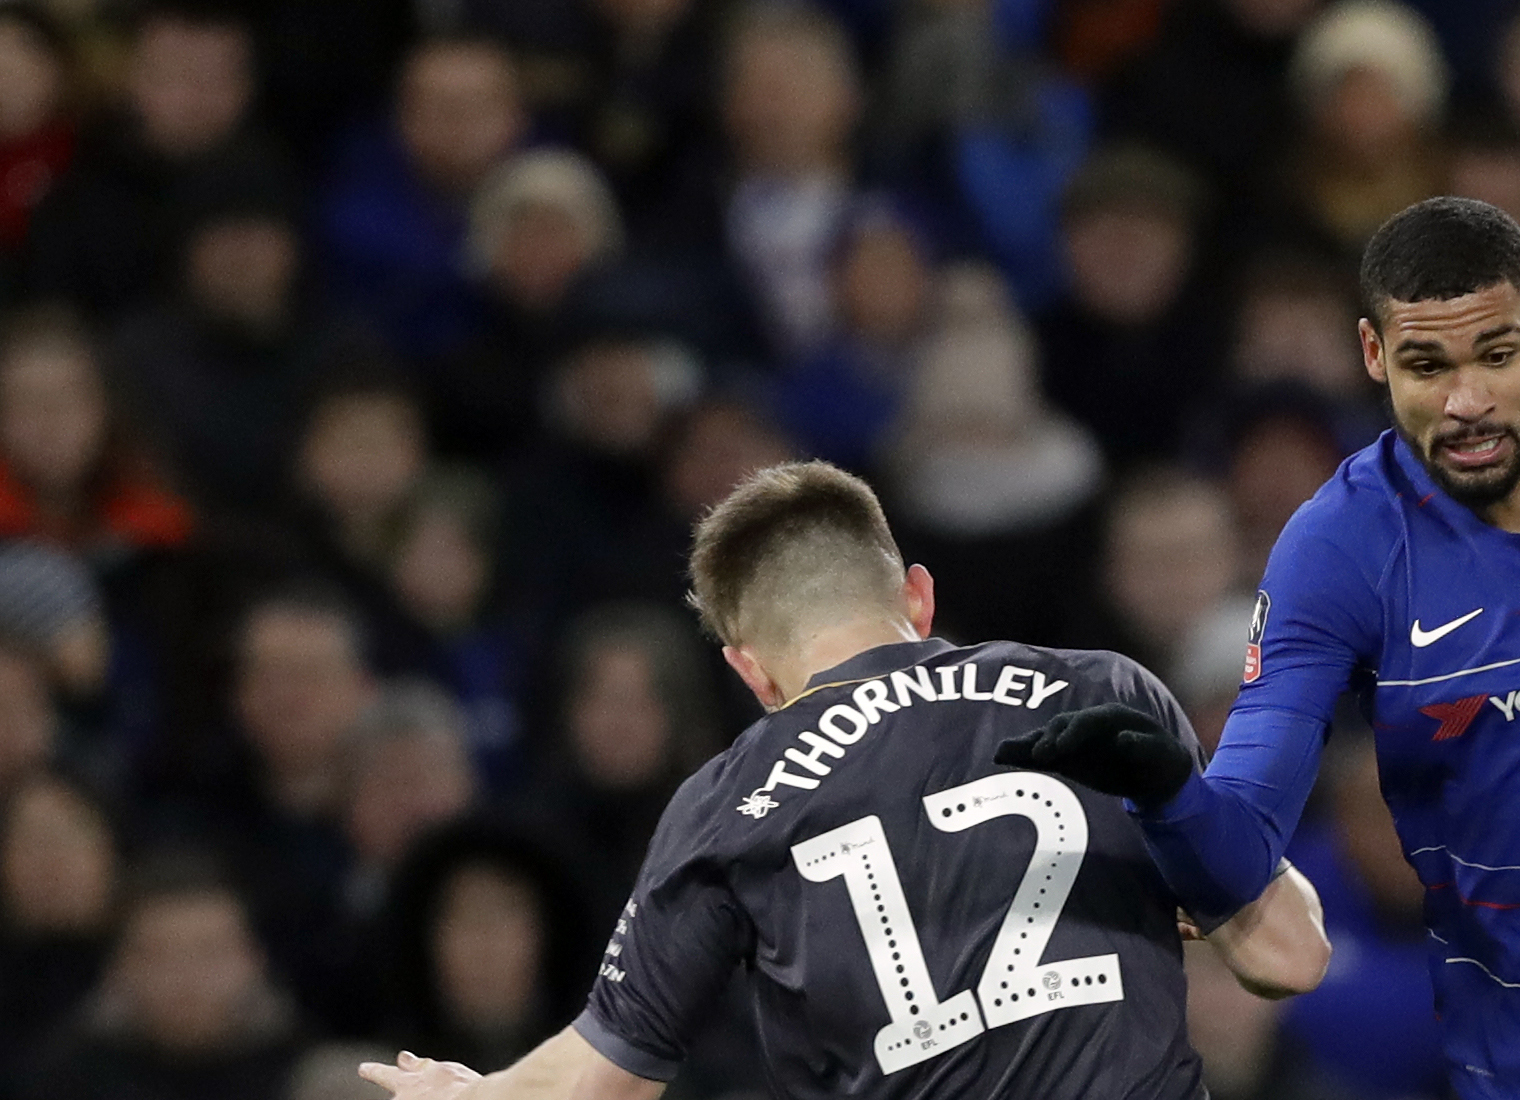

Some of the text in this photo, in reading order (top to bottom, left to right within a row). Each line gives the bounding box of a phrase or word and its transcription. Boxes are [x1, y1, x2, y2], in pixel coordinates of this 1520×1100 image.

[764, 662, 1069, 790] THORNILEY
[790, 771, 1124, 1076] 12
[1047, 990, 1065, 1002] EFL
[920, 1038, 939, 1051] EFL
